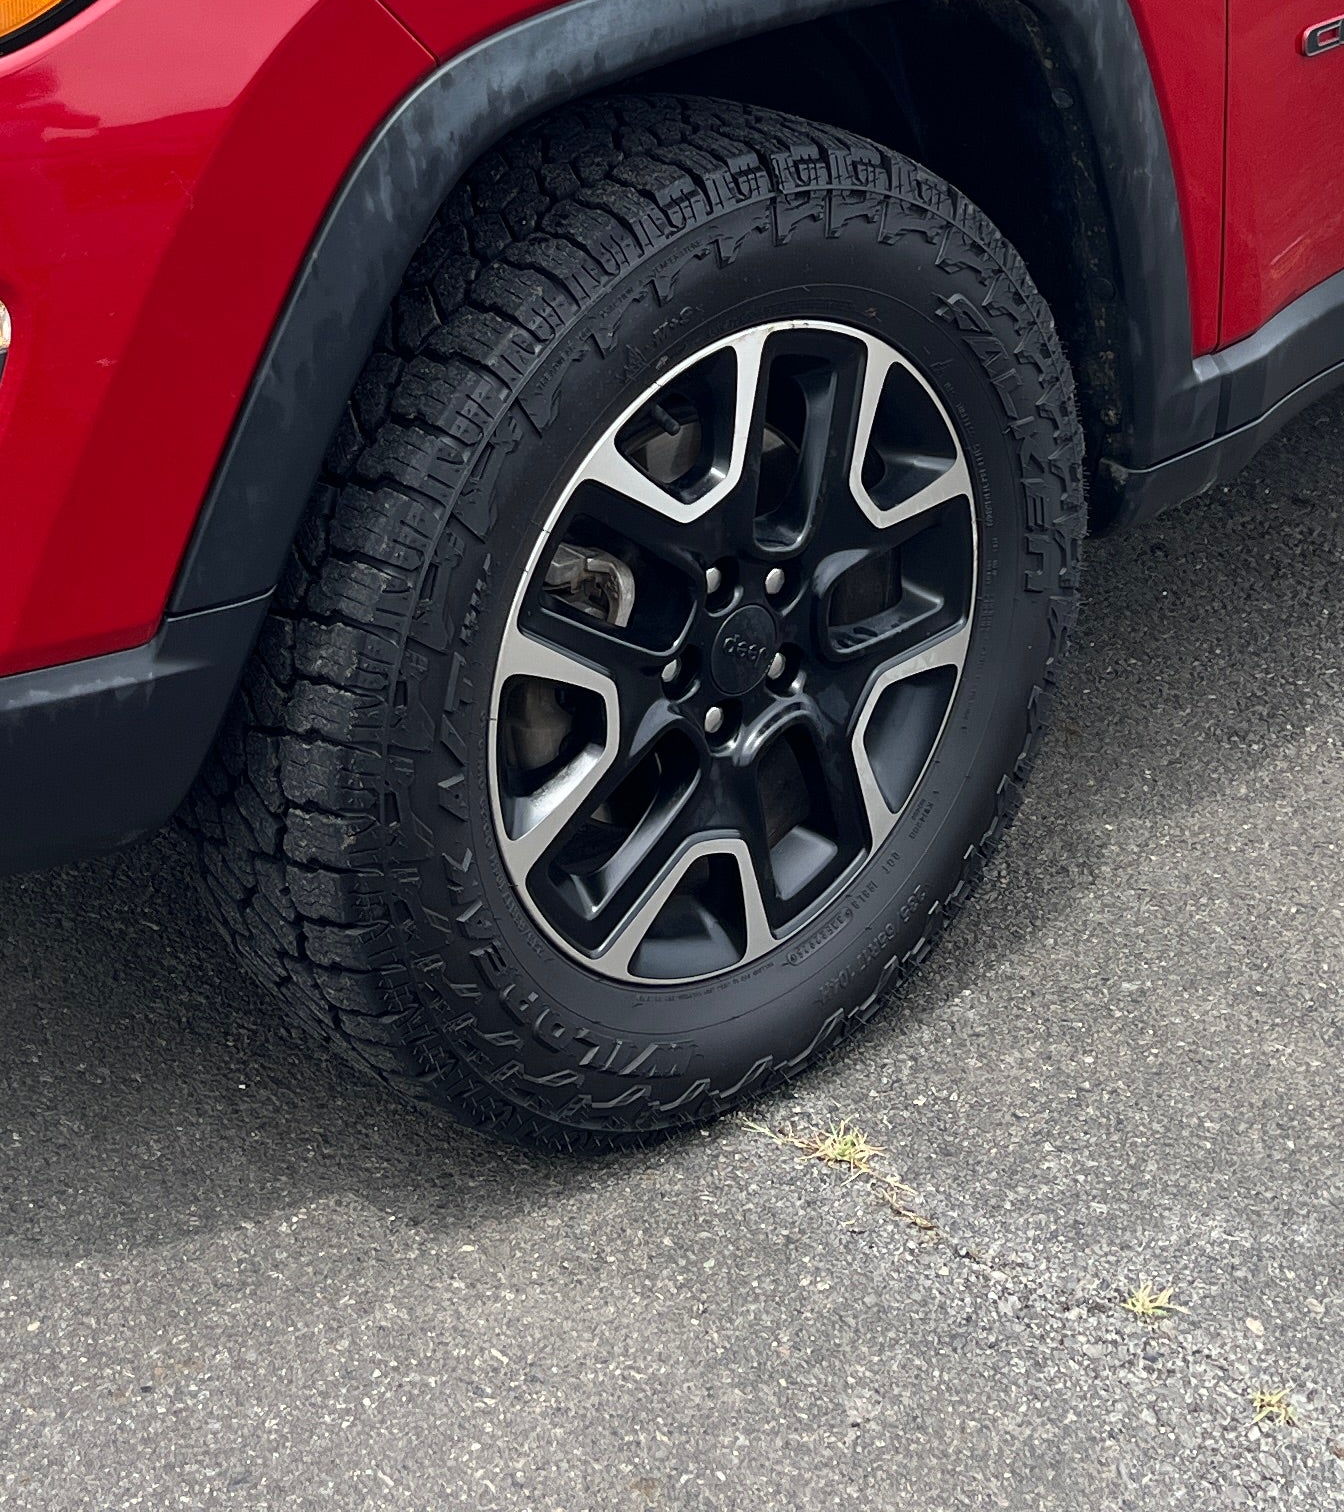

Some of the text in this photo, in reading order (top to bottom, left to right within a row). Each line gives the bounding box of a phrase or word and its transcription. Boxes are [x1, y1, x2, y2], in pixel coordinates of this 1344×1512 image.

[935, 293, 1058, 593] FALKEN
[722, 634, 767, 670] Jeep
[439, 843, 696, 1080] WILDPEAK
